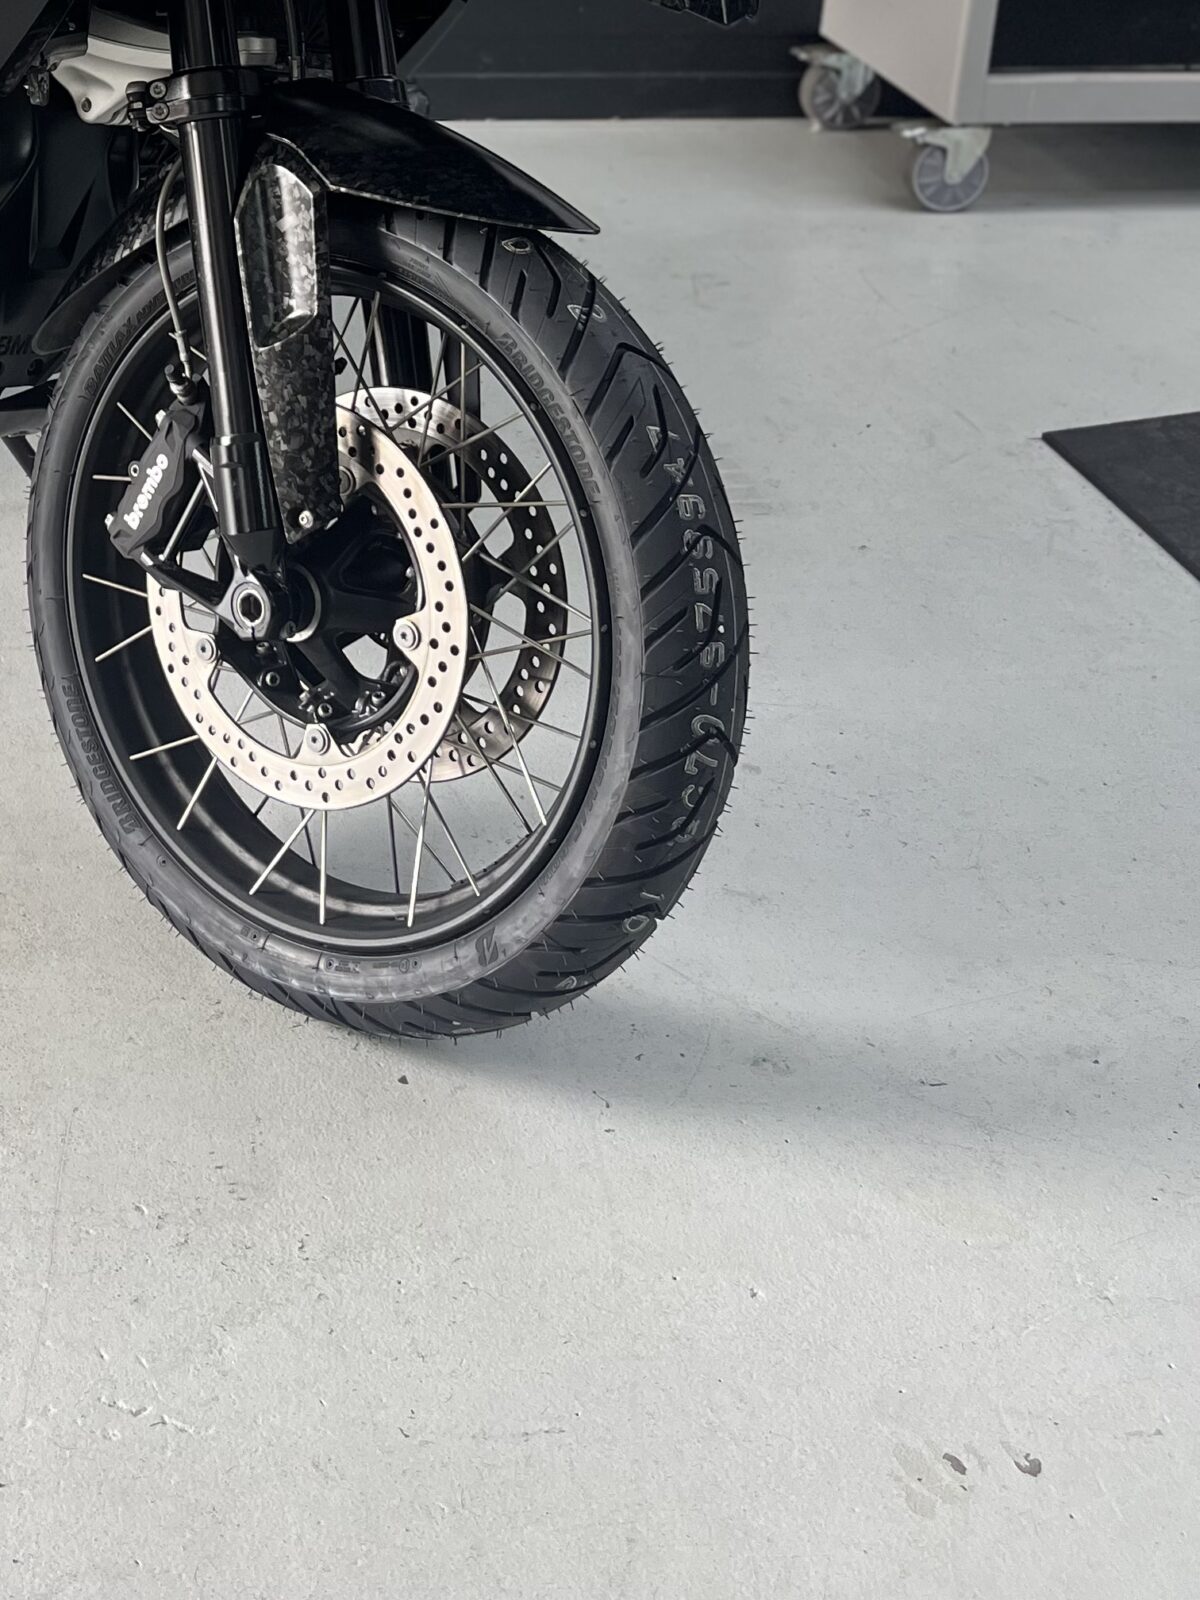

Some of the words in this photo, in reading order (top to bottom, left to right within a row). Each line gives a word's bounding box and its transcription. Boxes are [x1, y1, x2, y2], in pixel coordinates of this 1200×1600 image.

[497, 331, 602, 497] BRIDGESTONE
[122, 453, 169, 531] brembo
[61, 682, 143, 835] BRIDGESTONE
